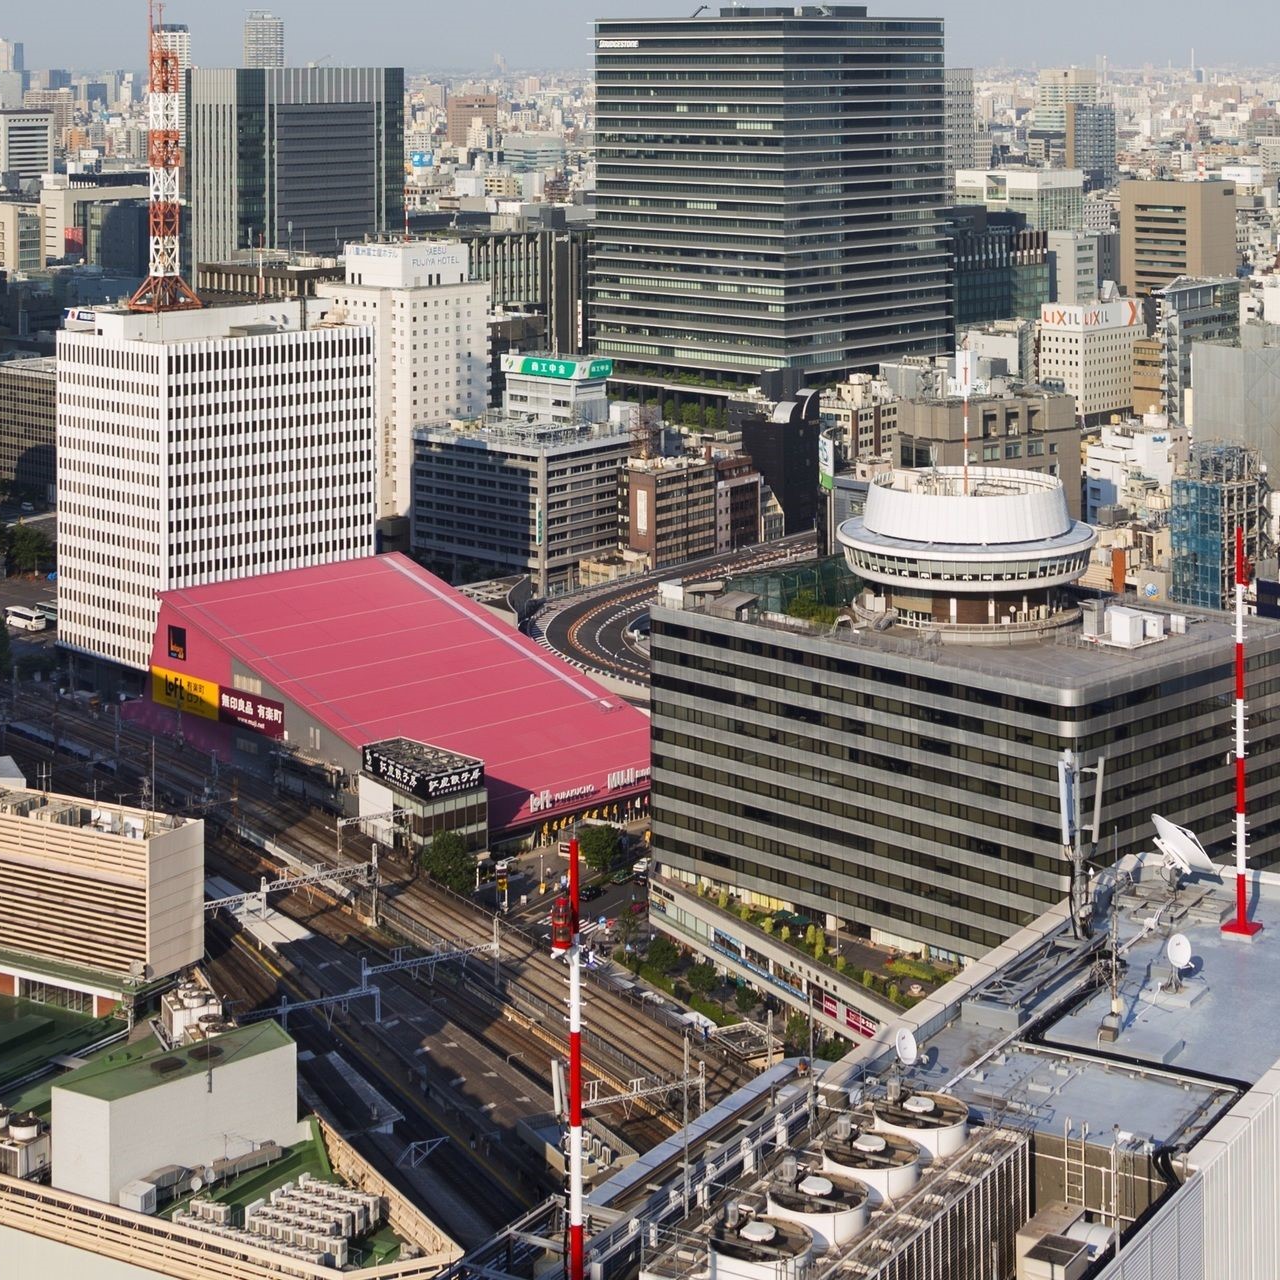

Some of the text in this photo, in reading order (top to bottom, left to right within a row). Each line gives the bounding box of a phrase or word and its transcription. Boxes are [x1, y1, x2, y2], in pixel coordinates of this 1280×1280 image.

[425, 246, 447, 255] YAESU
[412, 256, 460, 267] FUJIYA HOTEL
[1043, 310, 1080, 326] LIXIL
[1084, 311, 1109, 326] LIXIL
[531, 361, 566, 375] 商工中金
[591, 363, 610, 373] 商工中金
[221, 693, 282, 724] 無印良品 有楽町
[607, 767, 635, 790] MUJI
[554, 784, 595, 801] YURAKUCHO
